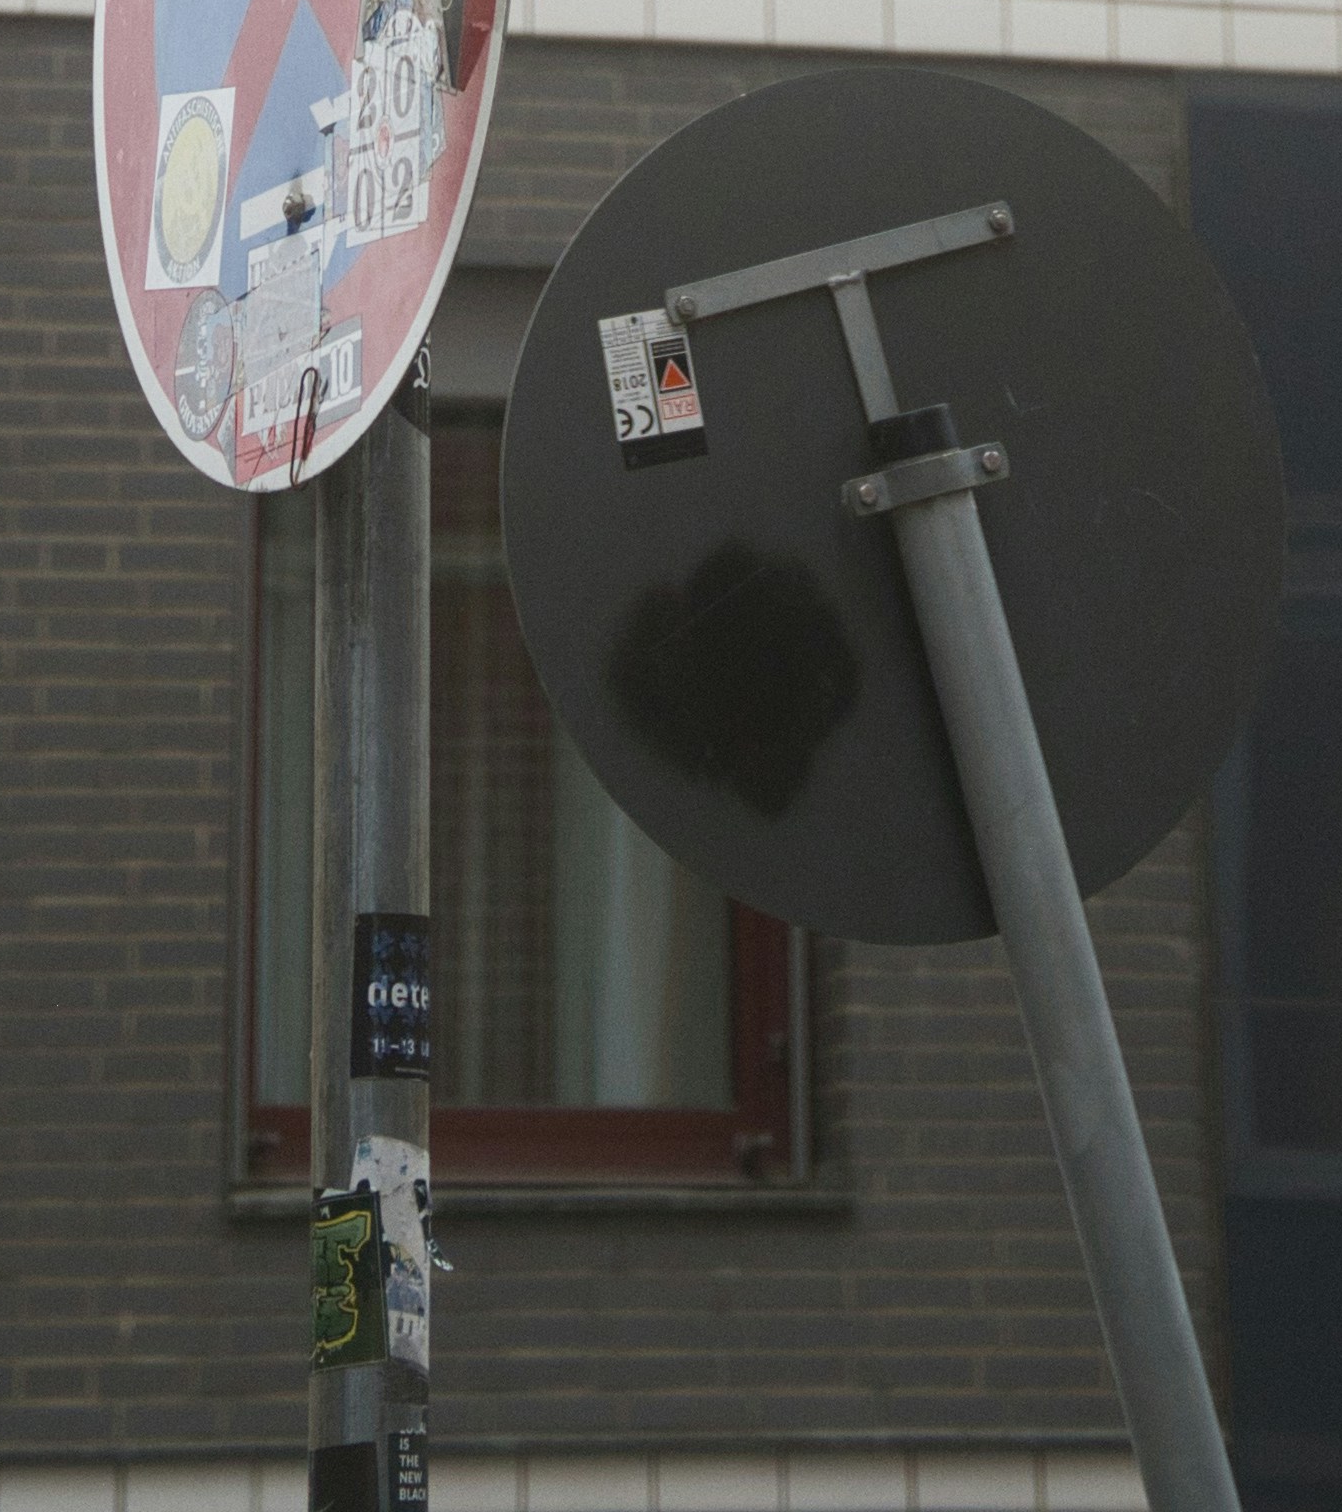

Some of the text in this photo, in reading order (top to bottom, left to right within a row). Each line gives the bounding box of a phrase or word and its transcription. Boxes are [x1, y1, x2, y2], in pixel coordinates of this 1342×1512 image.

[613, 373, 647, 392] 2018
[399, 1436, 411, 1452] IS
[399, 1455, 420, 1469] THE
[399, 1470, 423, 1485] NEW
